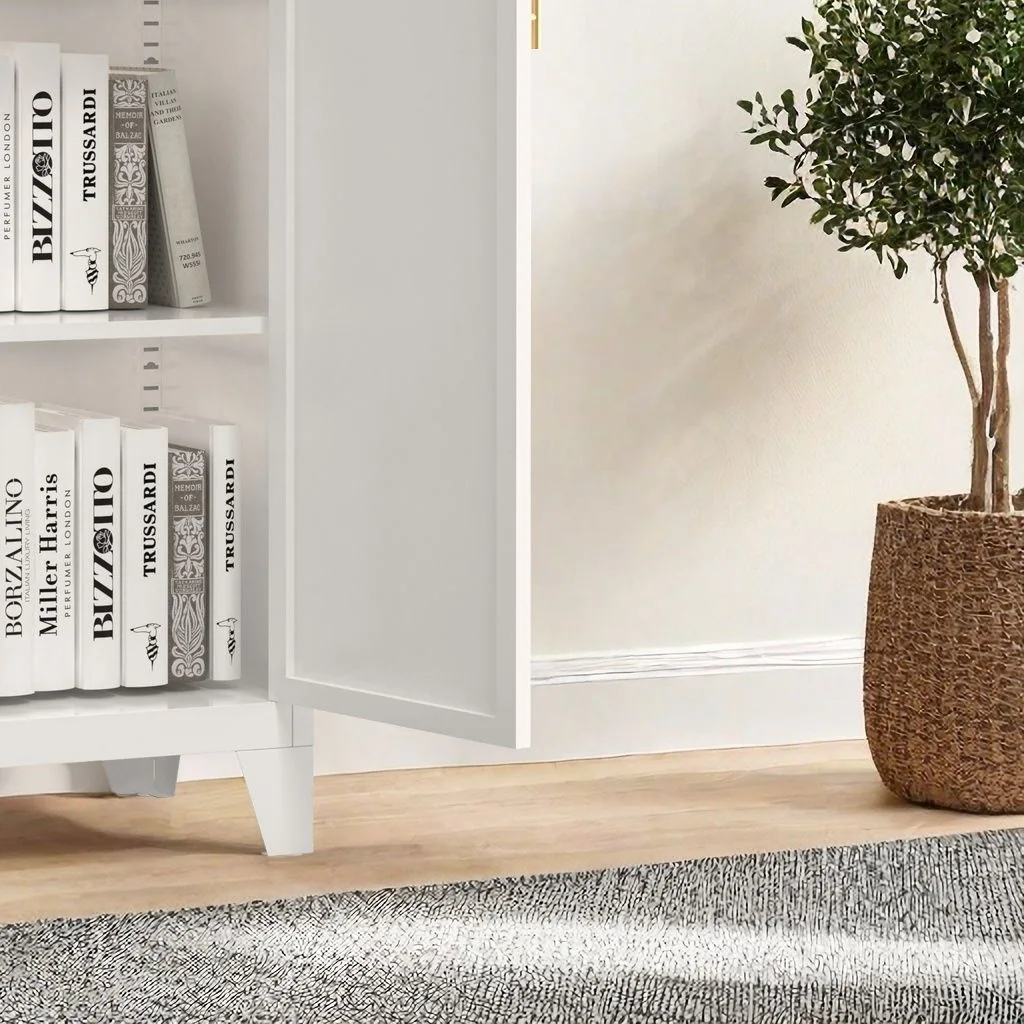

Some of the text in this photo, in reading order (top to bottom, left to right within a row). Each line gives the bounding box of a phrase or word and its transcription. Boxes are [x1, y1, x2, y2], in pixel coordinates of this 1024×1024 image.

[83, 88, 97, 202] TRUSSARDI
[115, 111, 144, 119] MEMOIR
[115, 131, 142, 139] BALZAC
[143, 463, 157, 578] TRUSSARDI
[174, 483, 202, 492] MEMOIR
[174, 503, 201, 512] BALZAC
[225, 458, 235, 572] TRUSSARDI
[5, 478, 23, 638] BORZALINO
[39, 473, 58, 637] Miller Harris
